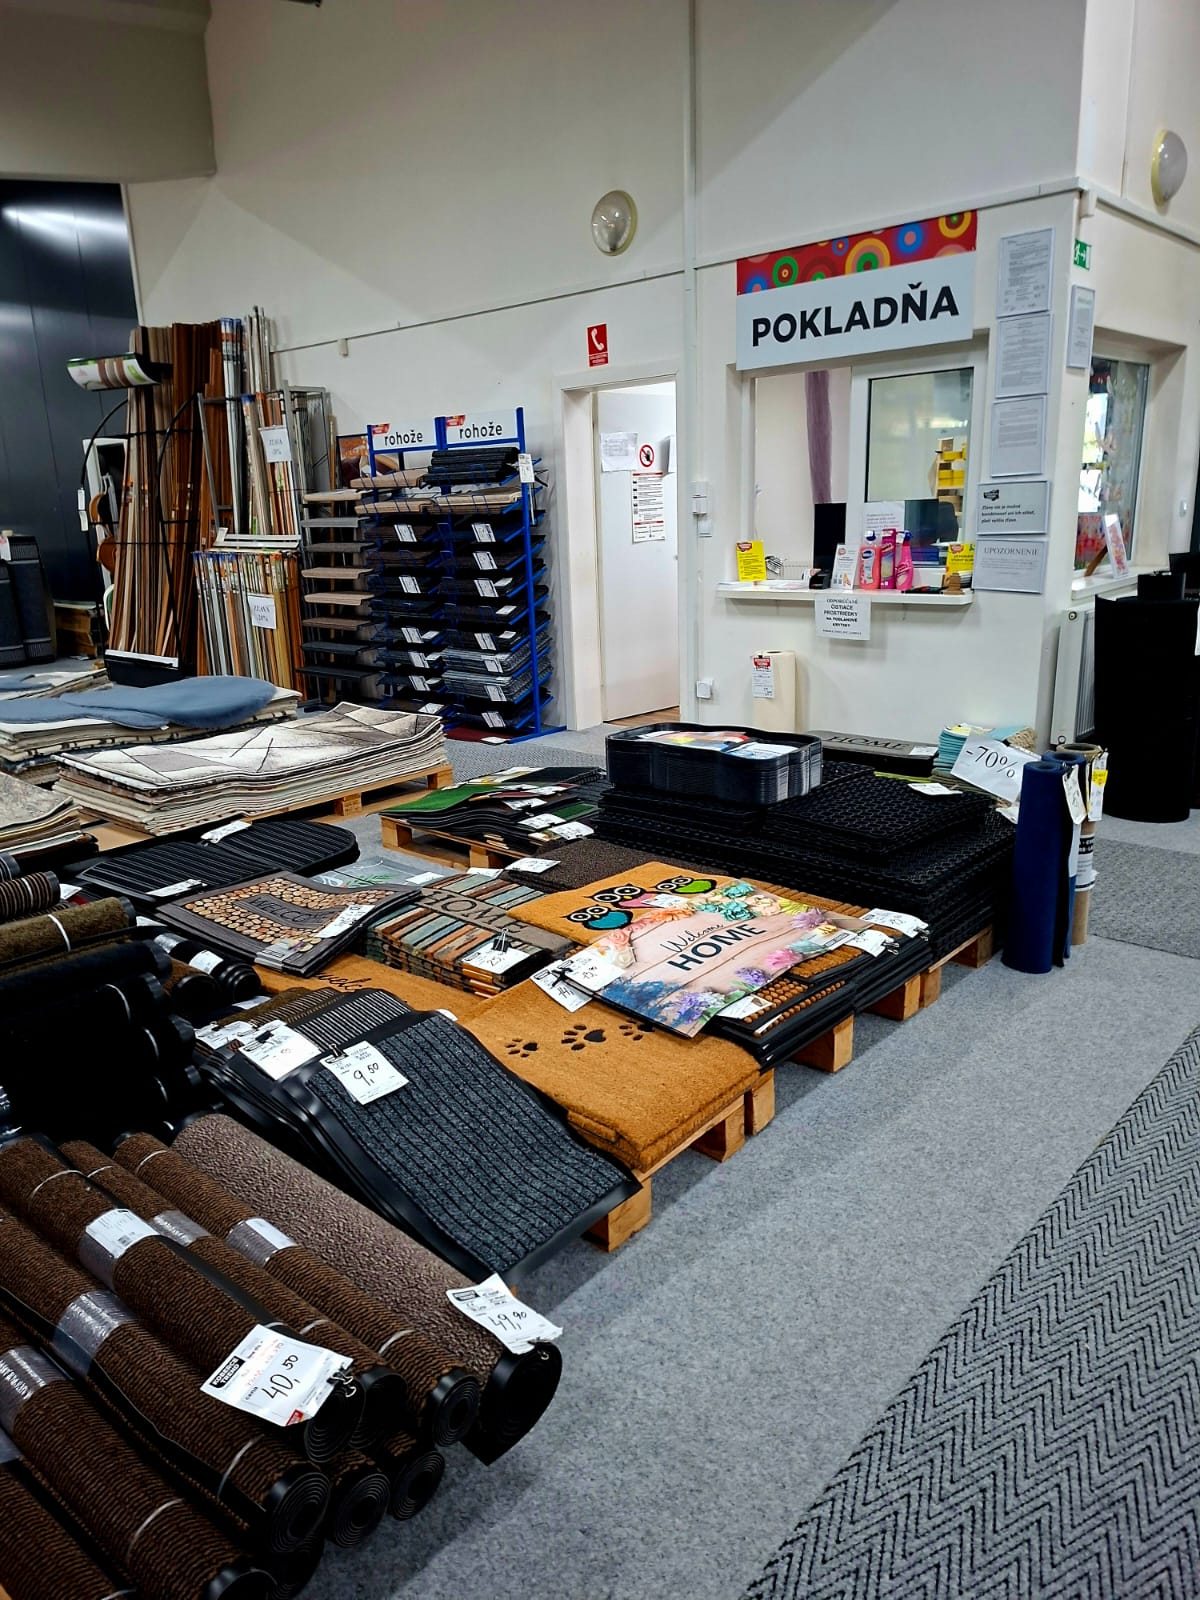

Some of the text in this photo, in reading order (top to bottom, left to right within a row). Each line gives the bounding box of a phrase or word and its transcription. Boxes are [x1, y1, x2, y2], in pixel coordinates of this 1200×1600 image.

[752, 282, 960, 347] POKLADŇA
[384, 430, 423, 446] rohože
[459, 422, 503, 439] rohože
[827, 736, 910, 750] HOME
[965, 745, 1018, 778] -70%
[422, 890, 529, 933] HOME
[660, 924, 724, 953] Welcome
[667, 924, 767, 971] HOME
[213, 1357, 240, 1386] KOBERCE
[221, 1363, 240, 1384] TREND
